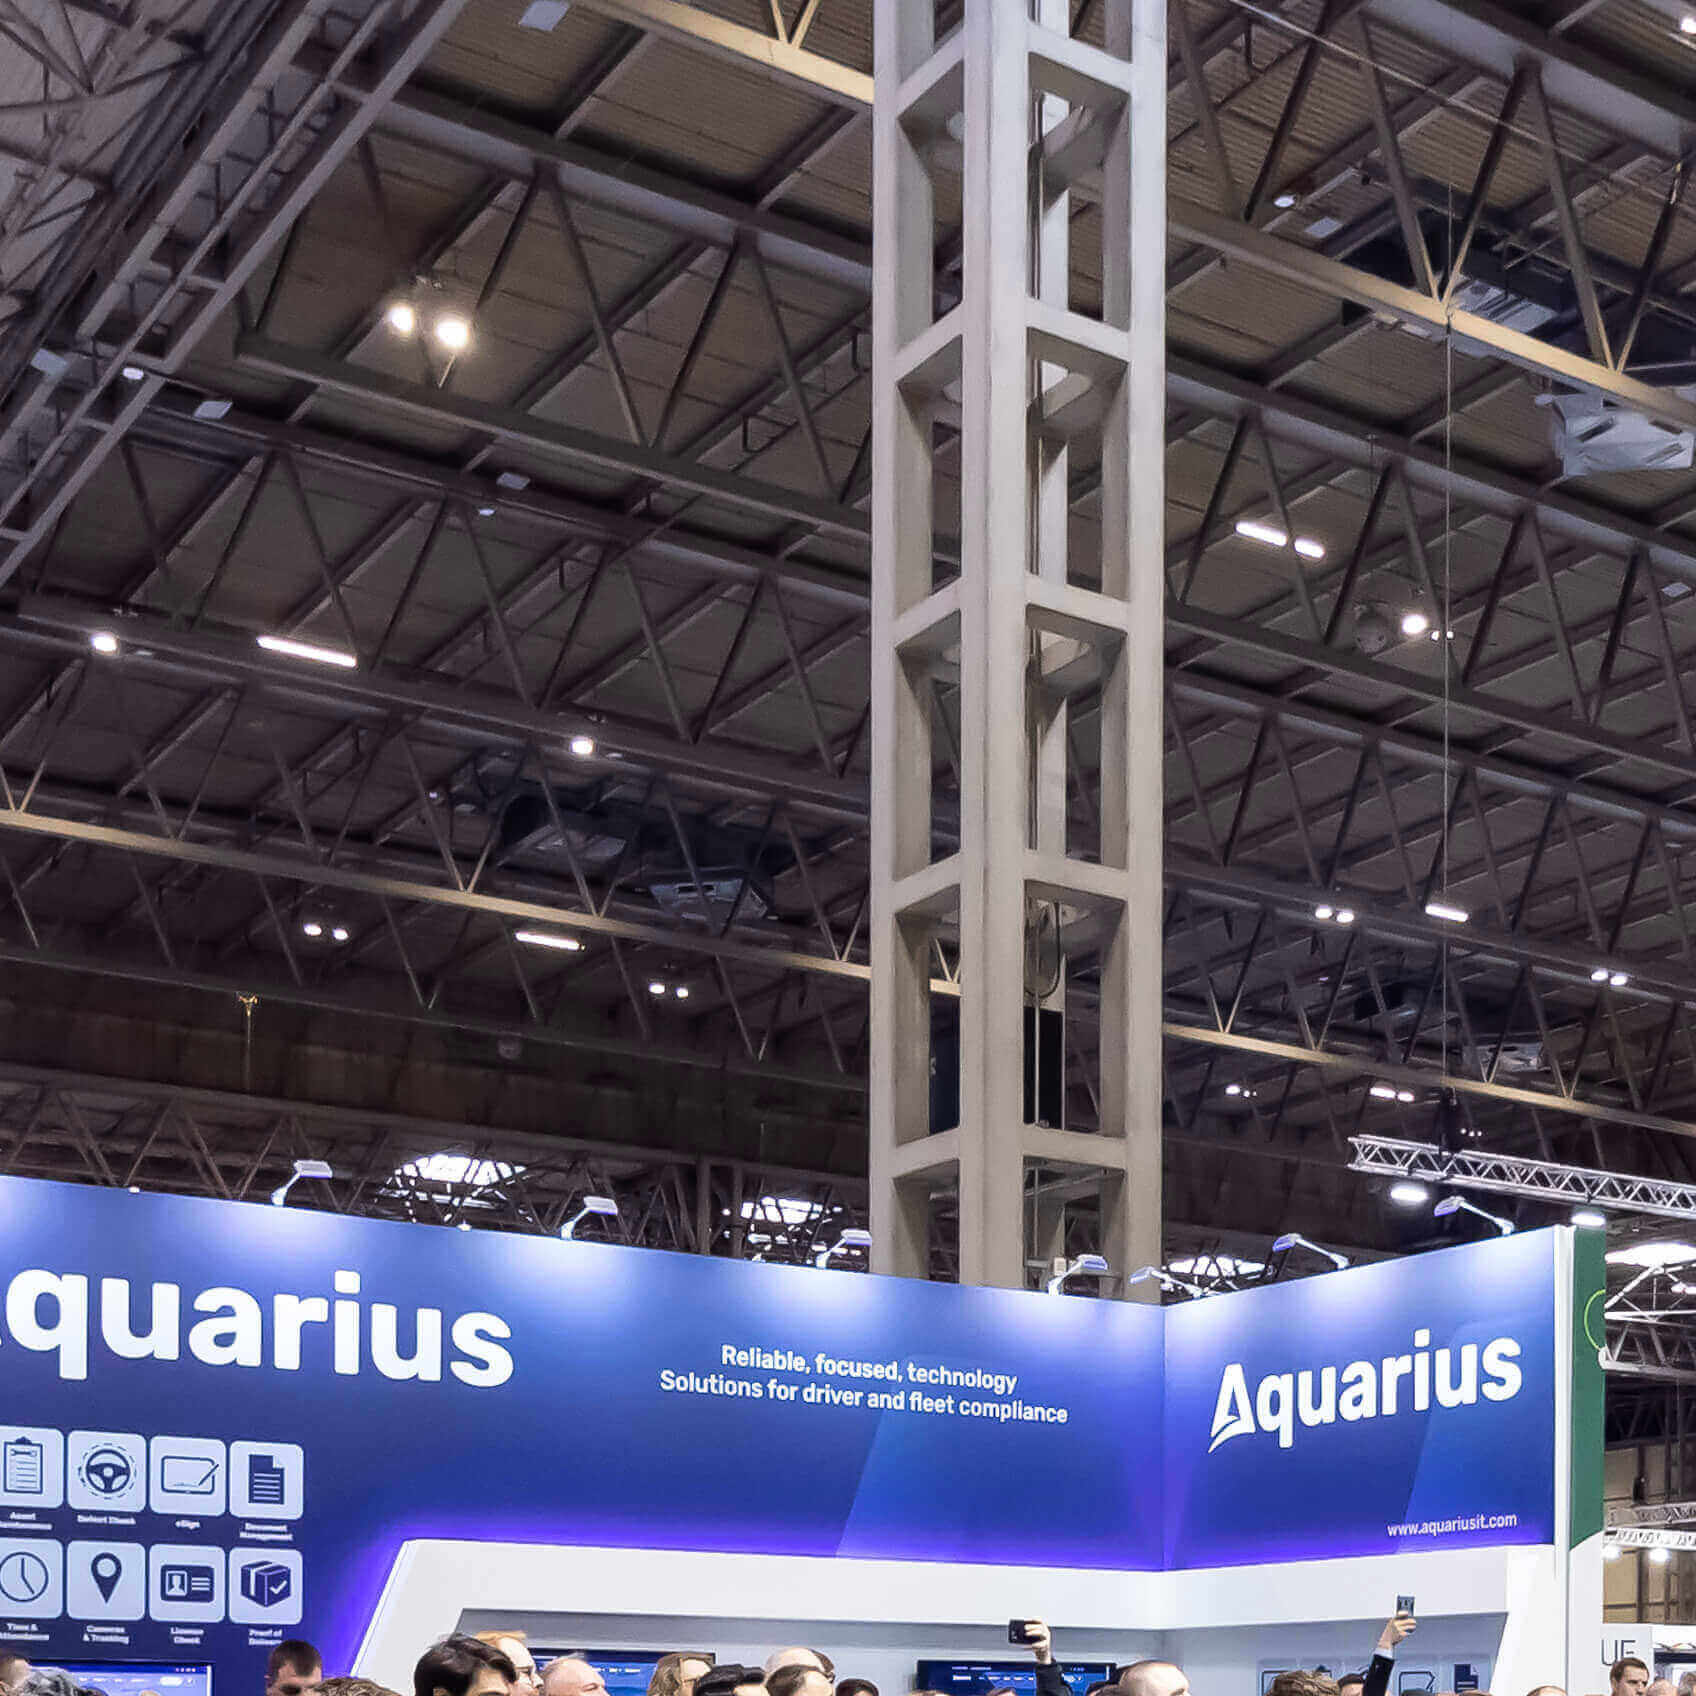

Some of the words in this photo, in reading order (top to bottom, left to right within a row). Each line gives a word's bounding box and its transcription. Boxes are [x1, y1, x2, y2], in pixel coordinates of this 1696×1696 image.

[721, 1344, 811, 1375] Reliable,
[815, 1353, 903, 1382] focused,
[907, 1362, 1018, 1395] technology
[1208, 1328, 1523, 1453] Aquarius
[660, 1369, 764, 1398] Solutions
[767, 1378, 799, 1401] for
[802, 1383, 864, 1406] driver
[867, 1391, 905, 1410] and
[908, 1391, 955, 1414] fleet
[959, 1400, 1068, 1423] compliance
[1387, 1512, 1518, 1537] www.aquariusit.com
